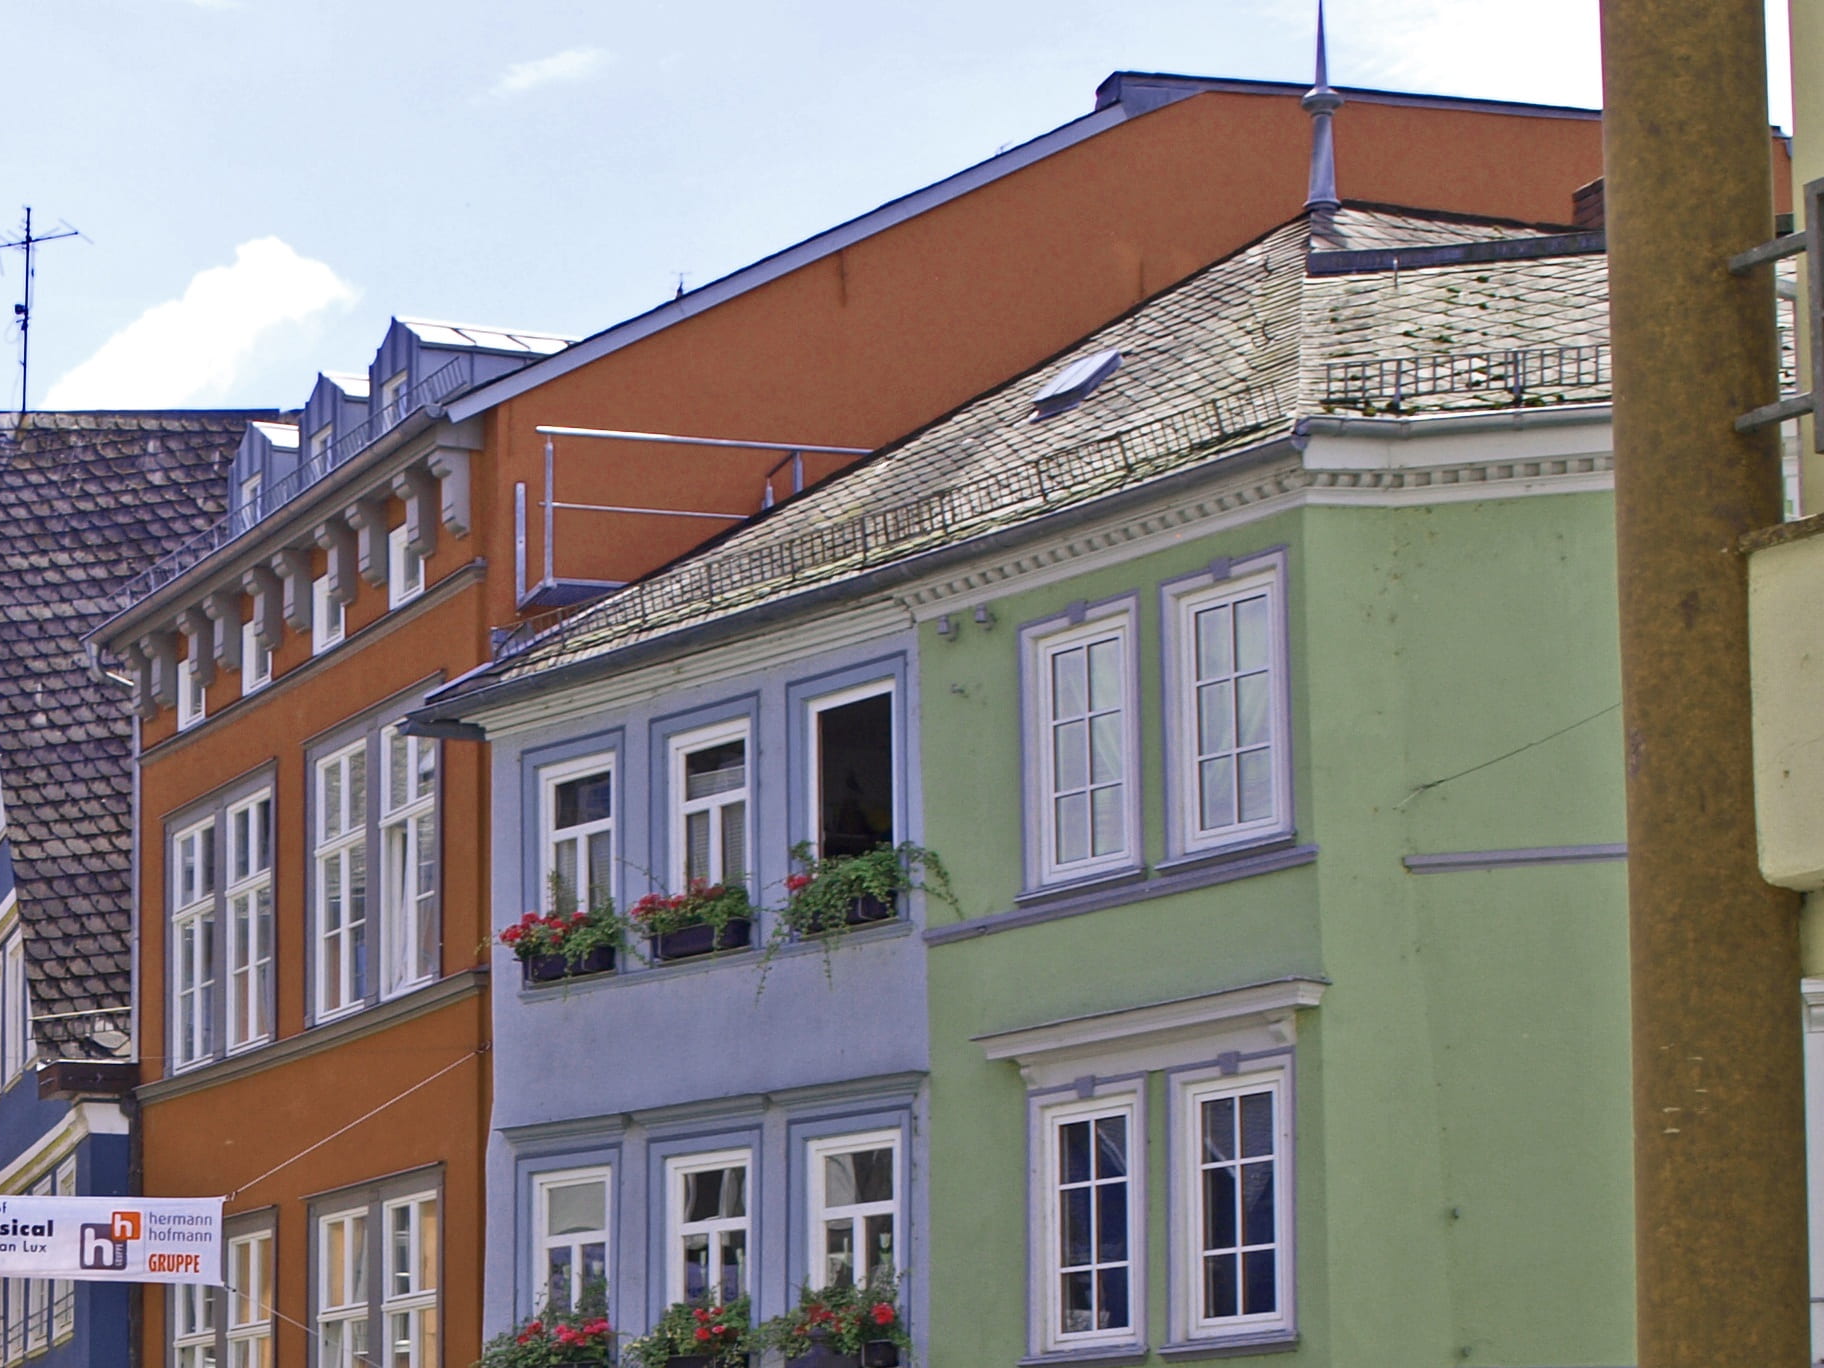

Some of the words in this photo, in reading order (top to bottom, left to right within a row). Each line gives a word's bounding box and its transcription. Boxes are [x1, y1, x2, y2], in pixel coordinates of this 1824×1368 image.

[148, 1212, 213, 1226] hermann
[148, 1228, 213, 1242] hofmann
[23, 1241, 48, 1253] Lux
[148, 1253, 201, 1273] GRUPPE
